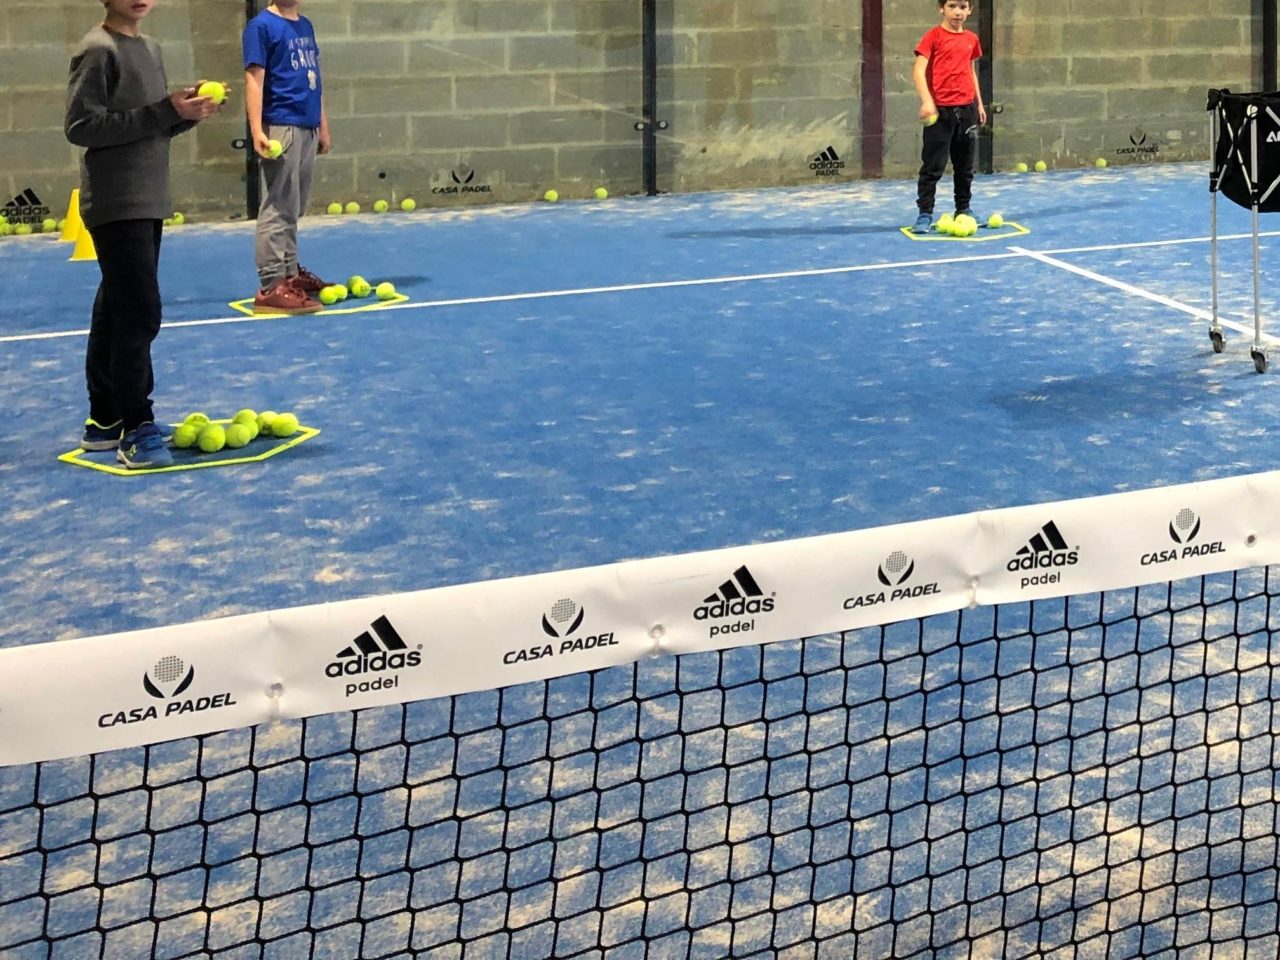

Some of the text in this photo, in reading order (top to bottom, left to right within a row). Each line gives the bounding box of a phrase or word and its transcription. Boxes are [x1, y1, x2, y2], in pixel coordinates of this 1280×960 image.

[809, 160, 845, 170] adidas
[432, 185, 492, 194] CASA PADEL
[0, 205, 50, 218] adidas
[1007, 549, 1079, 572] adidas
[1140, 541, 1226, 566] CASA PADEL
[1021, 572, 1061, 589] padel
[843, 583, 941, 610] CASA PADEL
[693, 596, 775, 621] adidas
[709, 619, 755, 638] padel
[503, 632, 619, 665] CASA PADEL
[325, 648, 422, 679] adidas
[345, 675, 399, 697] padel
[98, 692, 237, 728] CASA PADEL
